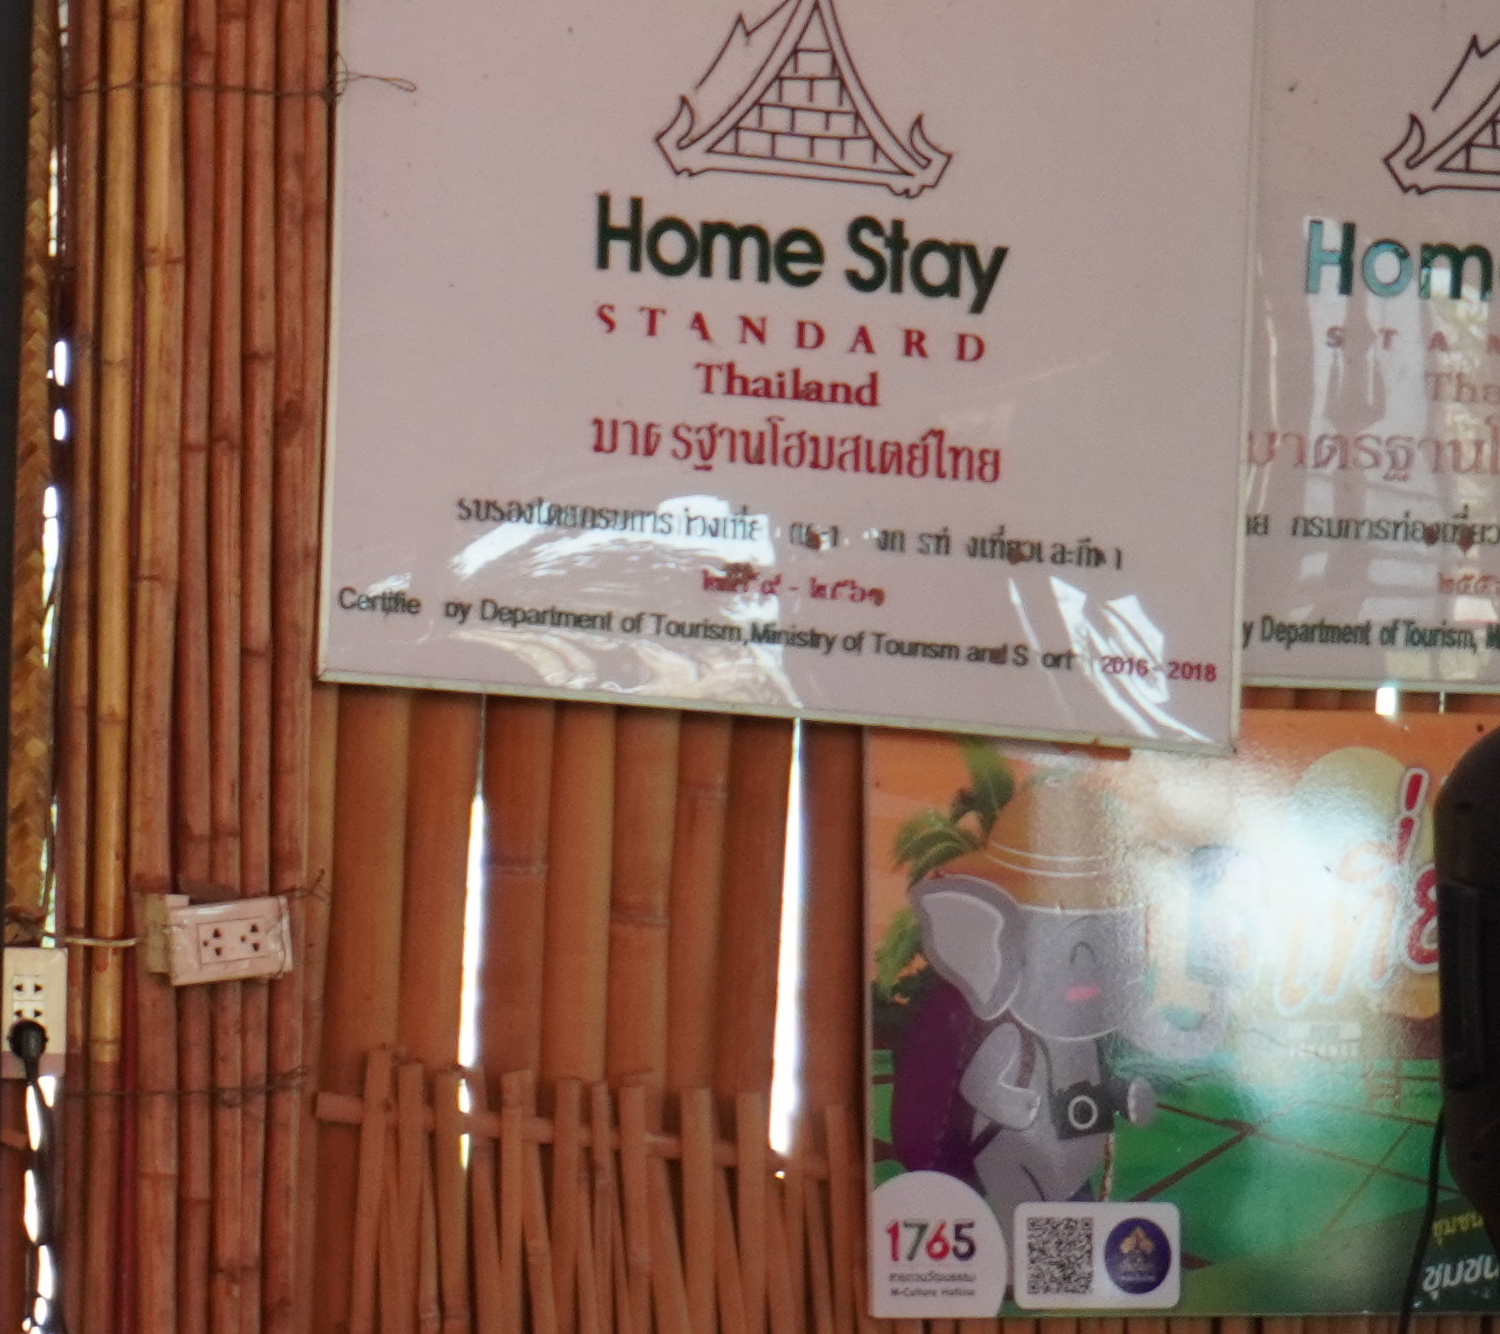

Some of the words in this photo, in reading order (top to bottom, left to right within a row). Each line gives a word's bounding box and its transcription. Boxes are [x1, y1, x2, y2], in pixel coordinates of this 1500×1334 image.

[596, 192, 825, 287] Home
[845, 215, 1009, 314] Stay
[1305, 219, 1500, 299] Hom
[597, 303, 986, 363] STANDARD
[695, 361, 880, 407] Thailand
[337, 586, 422, 619] Certifie
[480, 598, 612, 633] Department
[622, 610, 642, 634] of
[843, 631, 864, 653] of
[1100, 654, 1148, 677] 2016
[1168, 661, 1218, 683] 2018
[1261, 614, 1371, 650] Department
[886, 1220, 976, 1262] 1765
